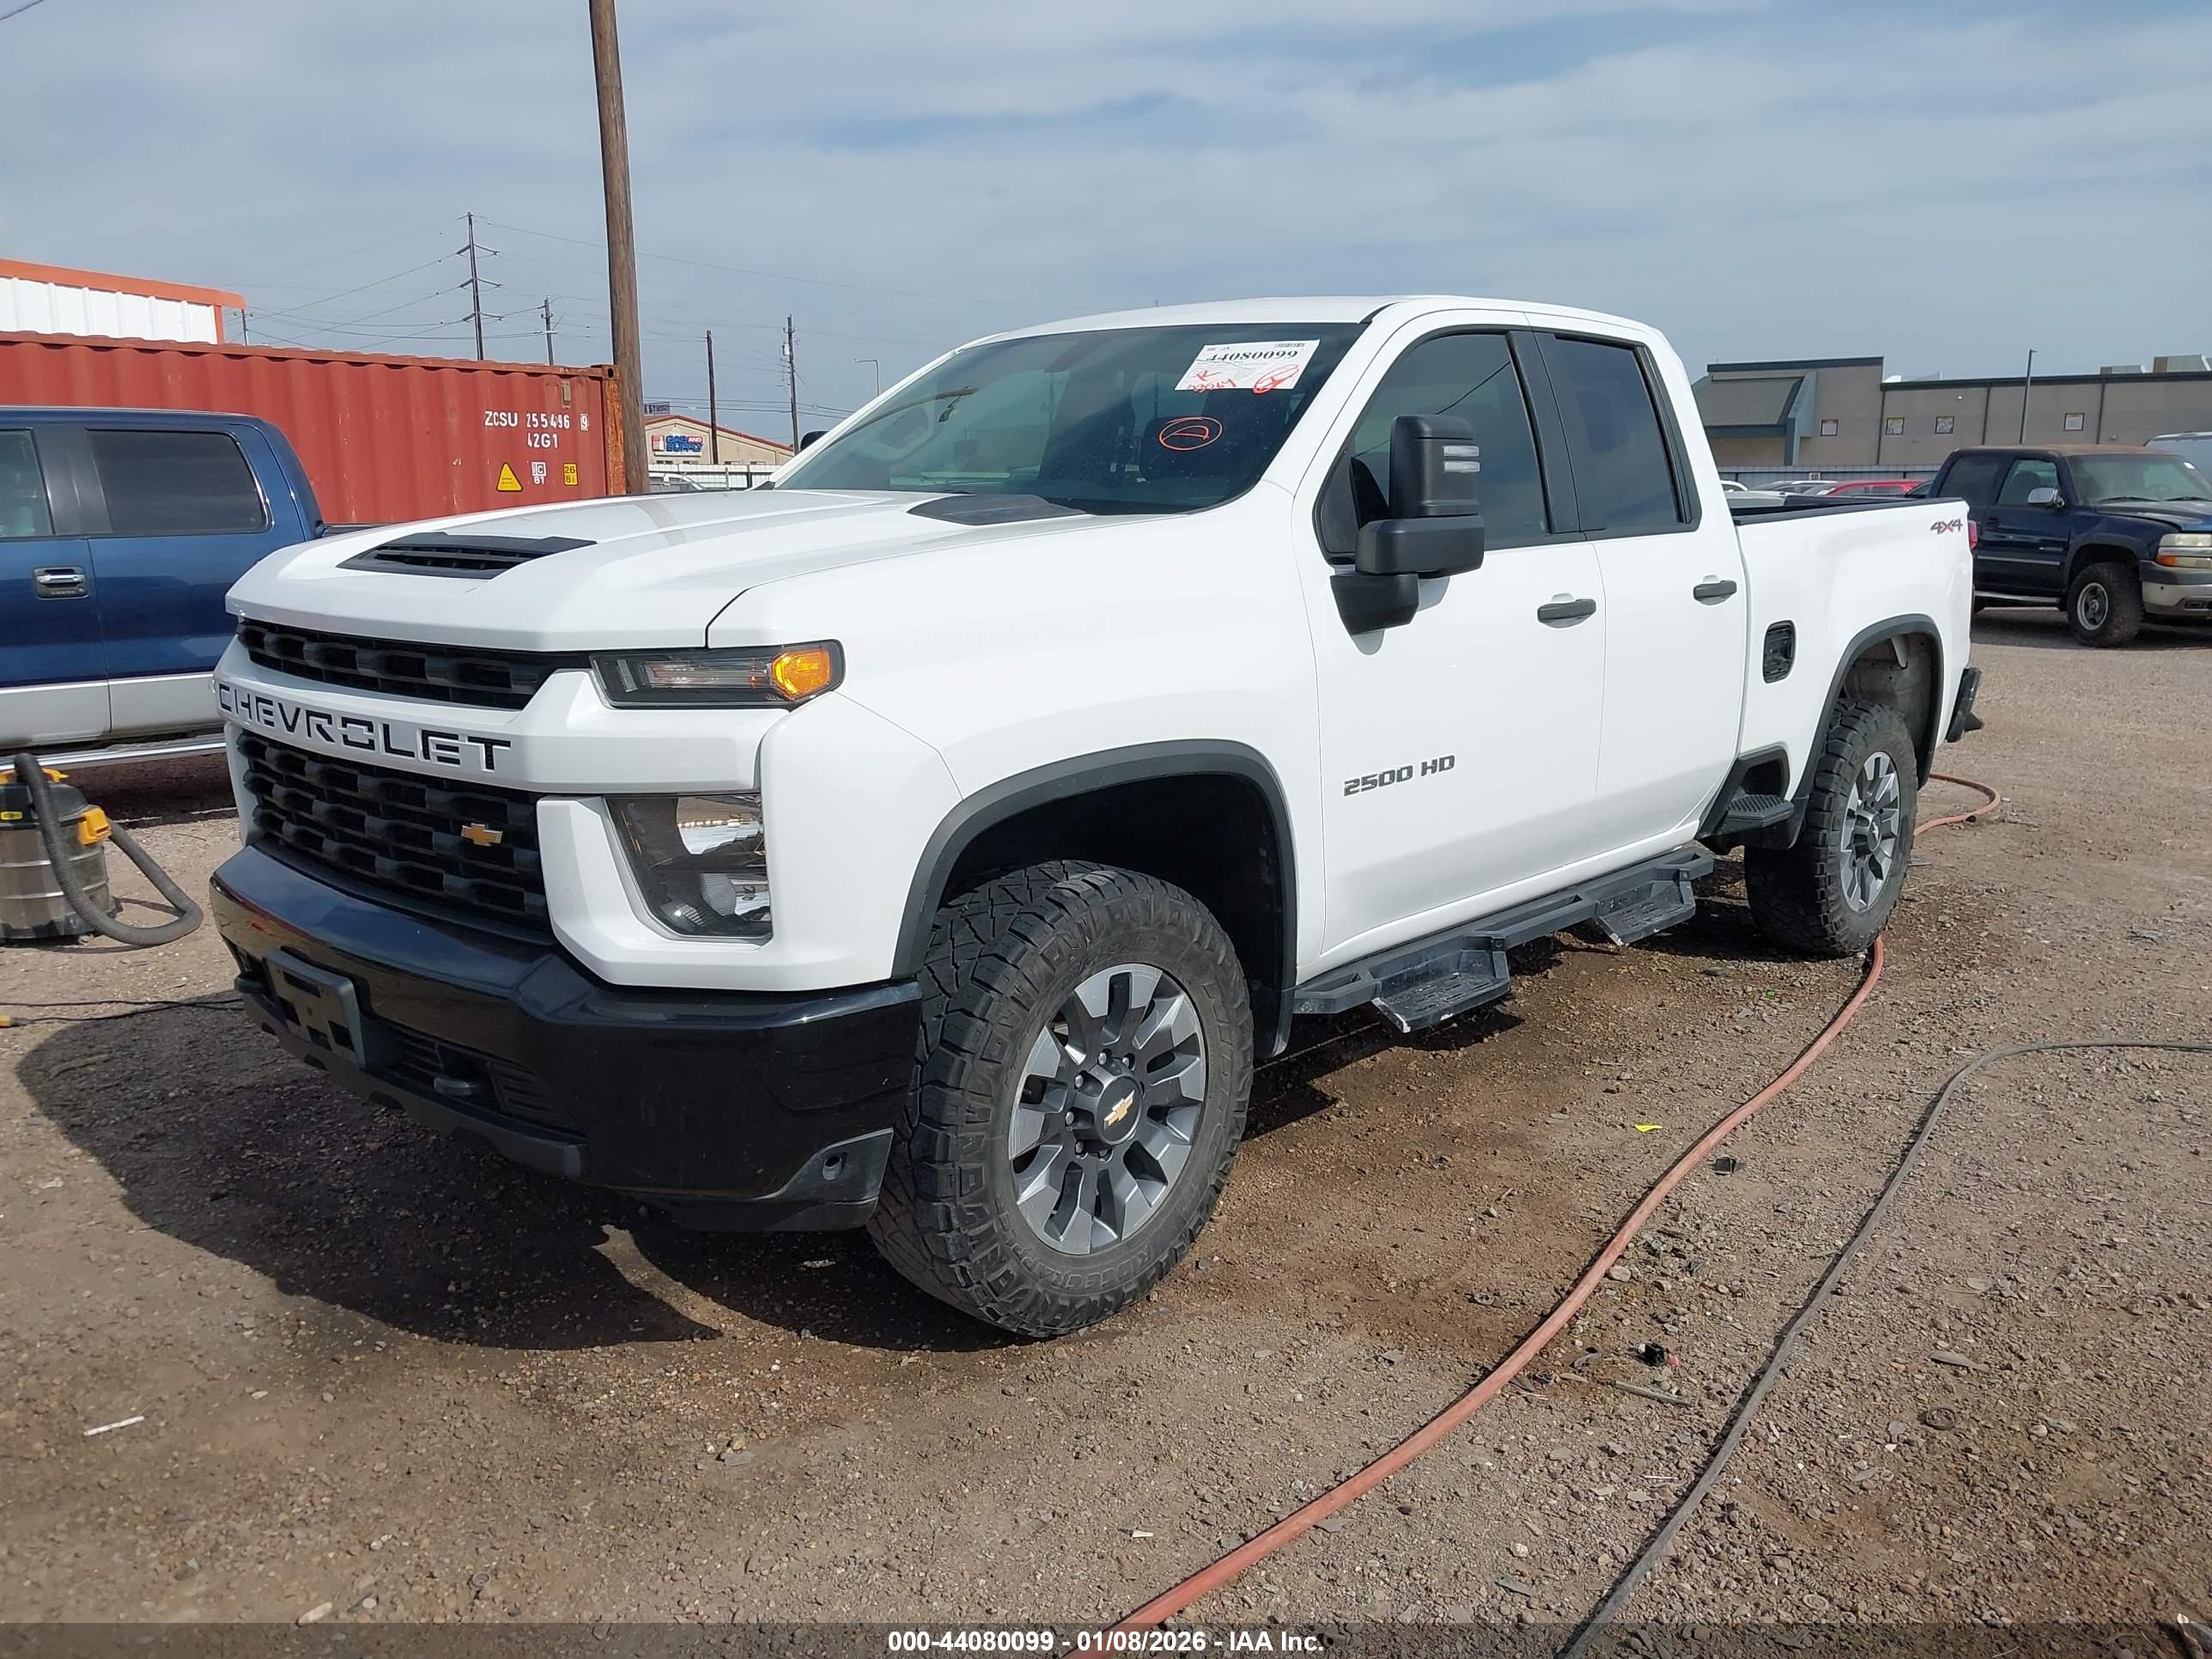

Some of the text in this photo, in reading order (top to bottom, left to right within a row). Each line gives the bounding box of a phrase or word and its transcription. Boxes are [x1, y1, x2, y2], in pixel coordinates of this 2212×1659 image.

[1206, 349, 1298, 362] 44080099
[484, 410, 519, 427] ZCSU
[526, 412, 570, 429] 255496
[526, 432, 558, 448] 42G1
[564, 465, 575, 474] 26
[534, 476, 544, 484] 81
[218, 683, 512, 772] CHEVROLET
[1343, 755, 1455, 797] 2500 HD
